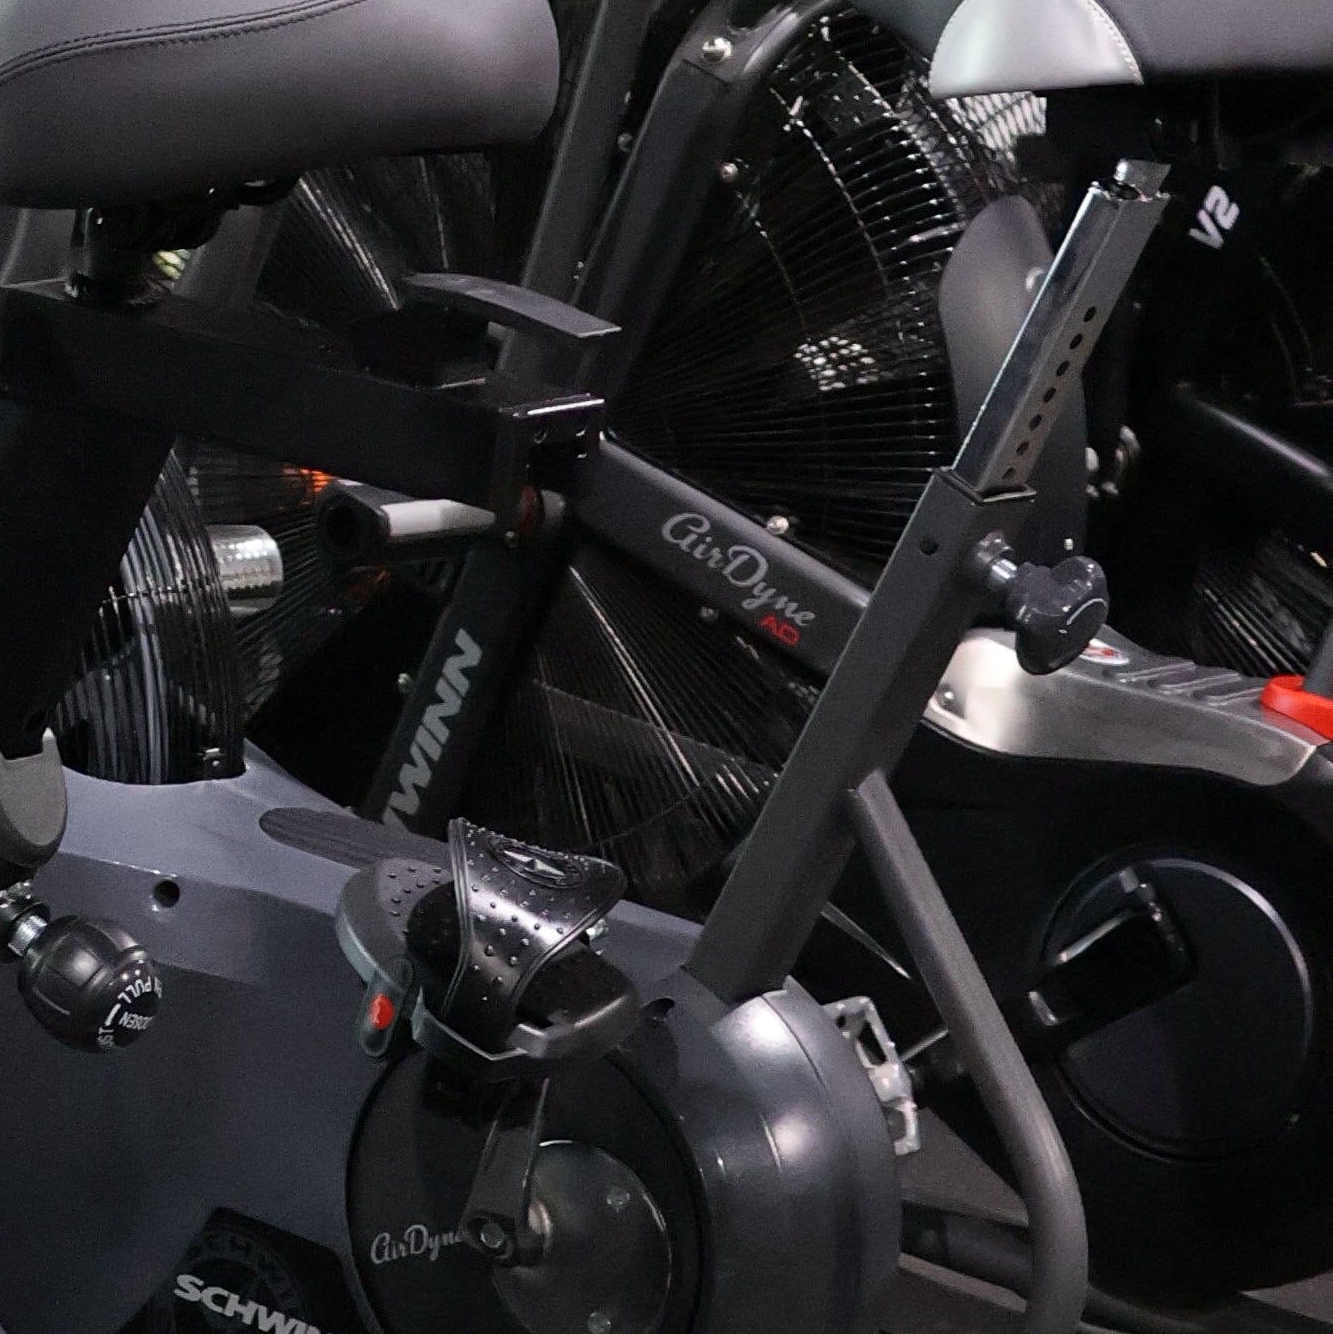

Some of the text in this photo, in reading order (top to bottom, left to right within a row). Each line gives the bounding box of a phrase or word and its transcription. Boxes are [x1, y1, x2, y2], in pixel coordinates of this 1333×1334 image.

[1189, 185, 1240, 249] V2
[661, 513, 817, 628] AirDyne
[383, 627, 483, 832] WINN
[117, 975, 153, 1004] PULL
